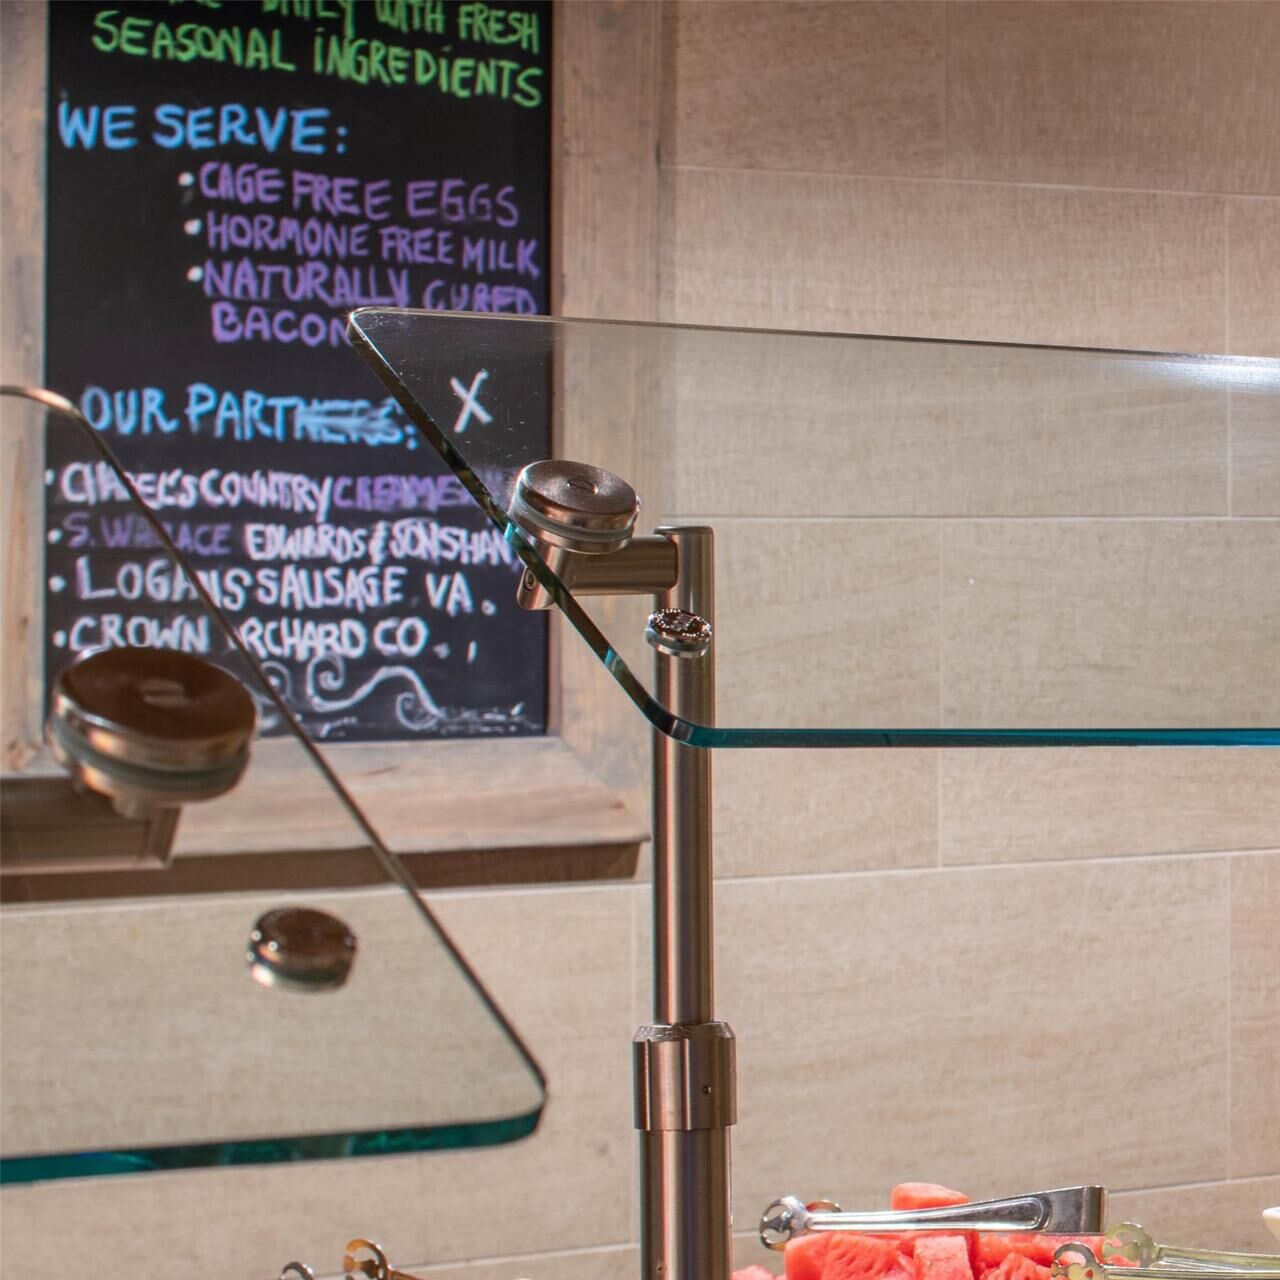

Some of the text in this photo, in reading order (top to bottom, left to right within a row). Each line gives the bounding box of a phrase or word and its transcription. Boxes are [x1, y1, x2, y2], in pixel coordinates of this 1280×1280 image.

[458, 2, 540, 54] FRESH
[92, 11, 543, 107] SEASONAL INGREDIENTS
[57, 101, 350, 154] WE SERVE:
[199, 161, 519, 227] CAGE FREE EGGS
[206, 213, 540, 280] HORMONE FREE MILK
[202, 257, 409, 308] NATURALLY
[211, 301, 353, 348] BACON
[80, 385, 180, 435] OUR
[199, 468, 333, 522] COUNTRY
[256, 565, 409, 610] SAUSAGE
[68, 613, 211, 654] CROWN
[226, 615, 368, 662] RCHARD
